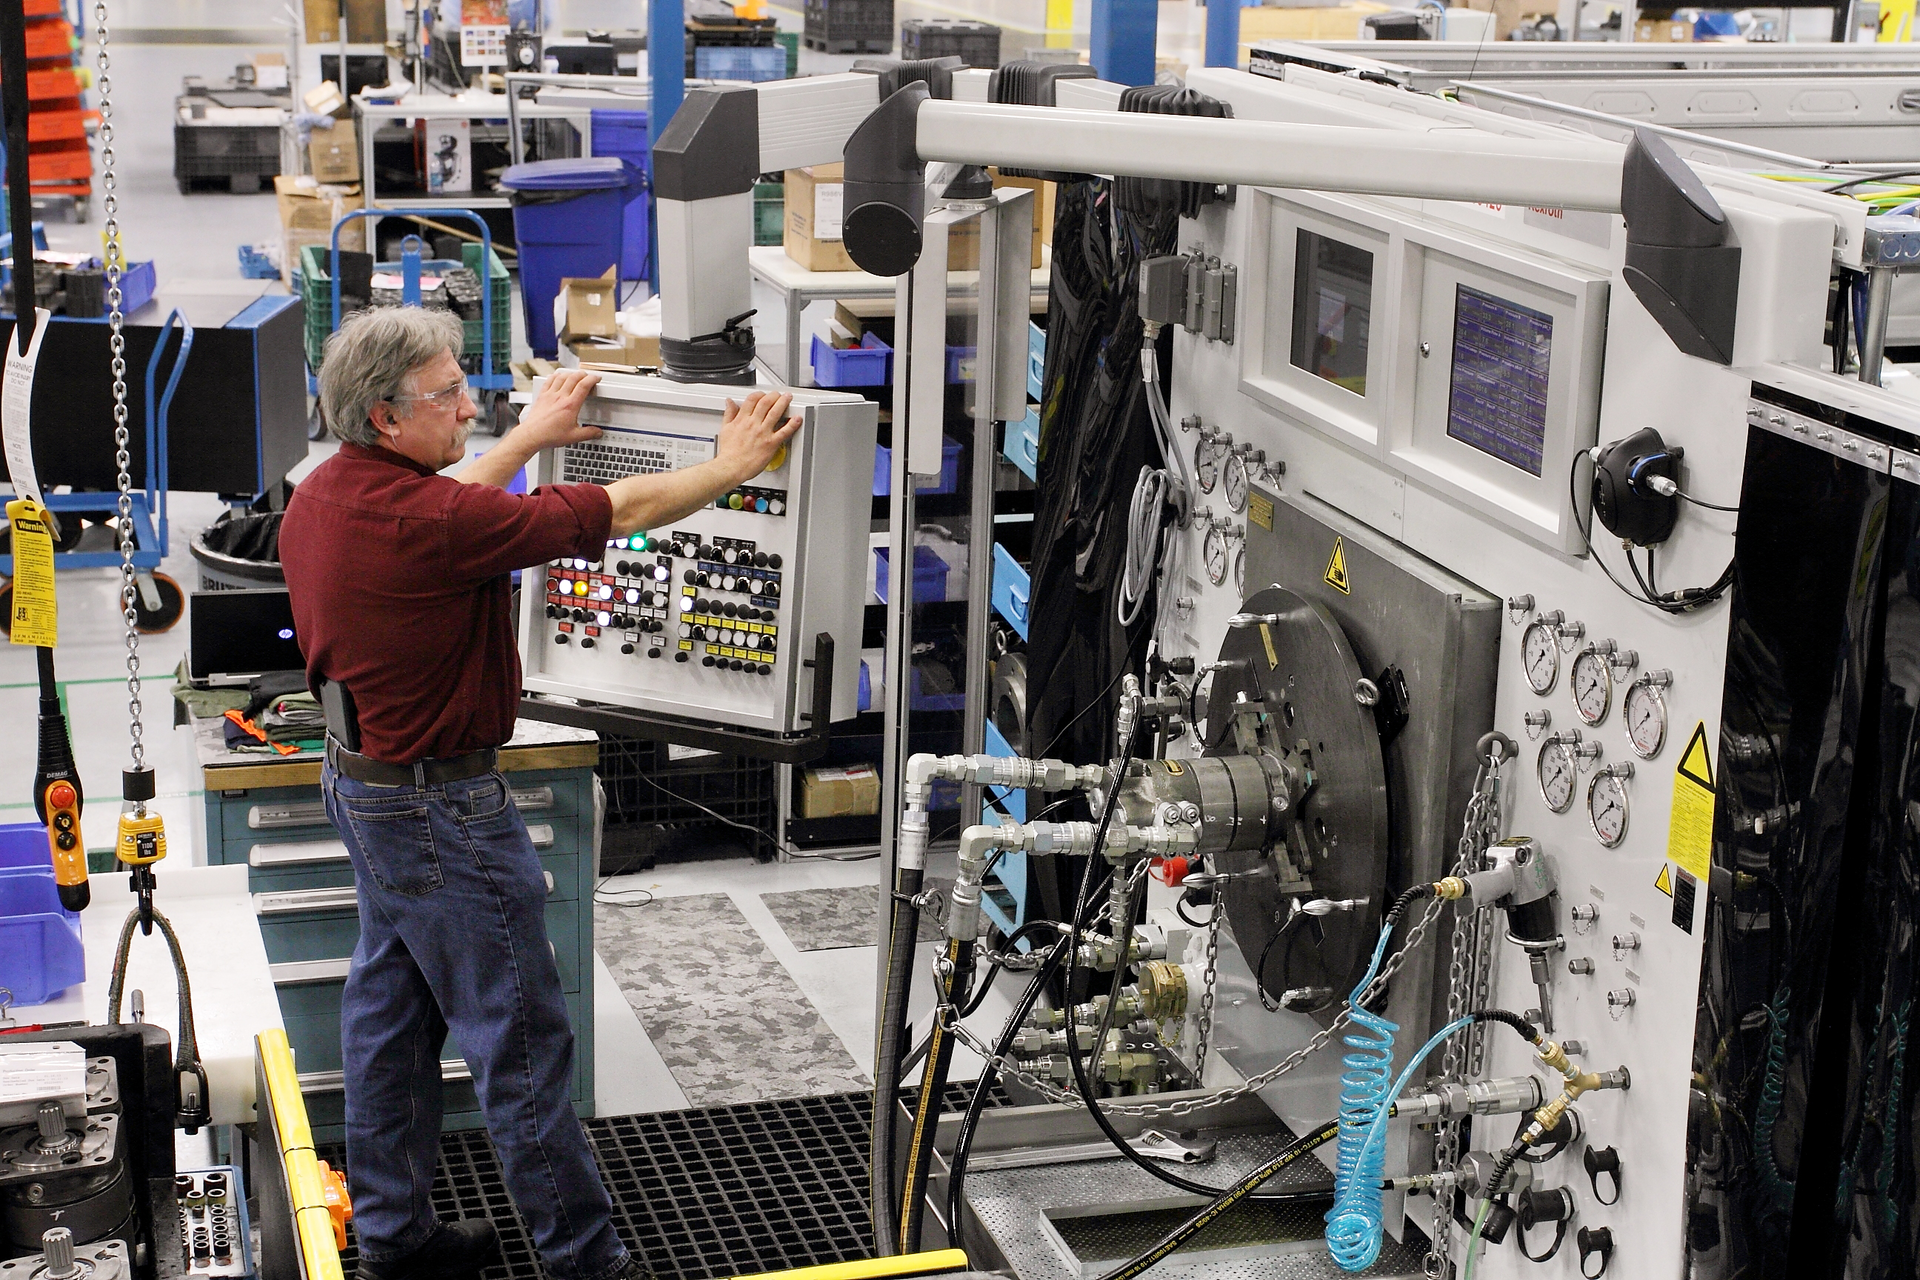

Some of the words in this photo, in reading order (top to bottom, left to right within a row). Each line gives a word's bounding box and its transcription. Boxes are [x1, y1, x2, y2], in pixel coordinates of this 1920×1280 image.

[8, 360, 33, 374] WARNING
[18, 521, 48, 533] Warning
[46, 770, 68, 779] DEMAG
[1282, 1152, 1294, 1163] WP
[1215, 1195, 1235, 1212] MSHA
